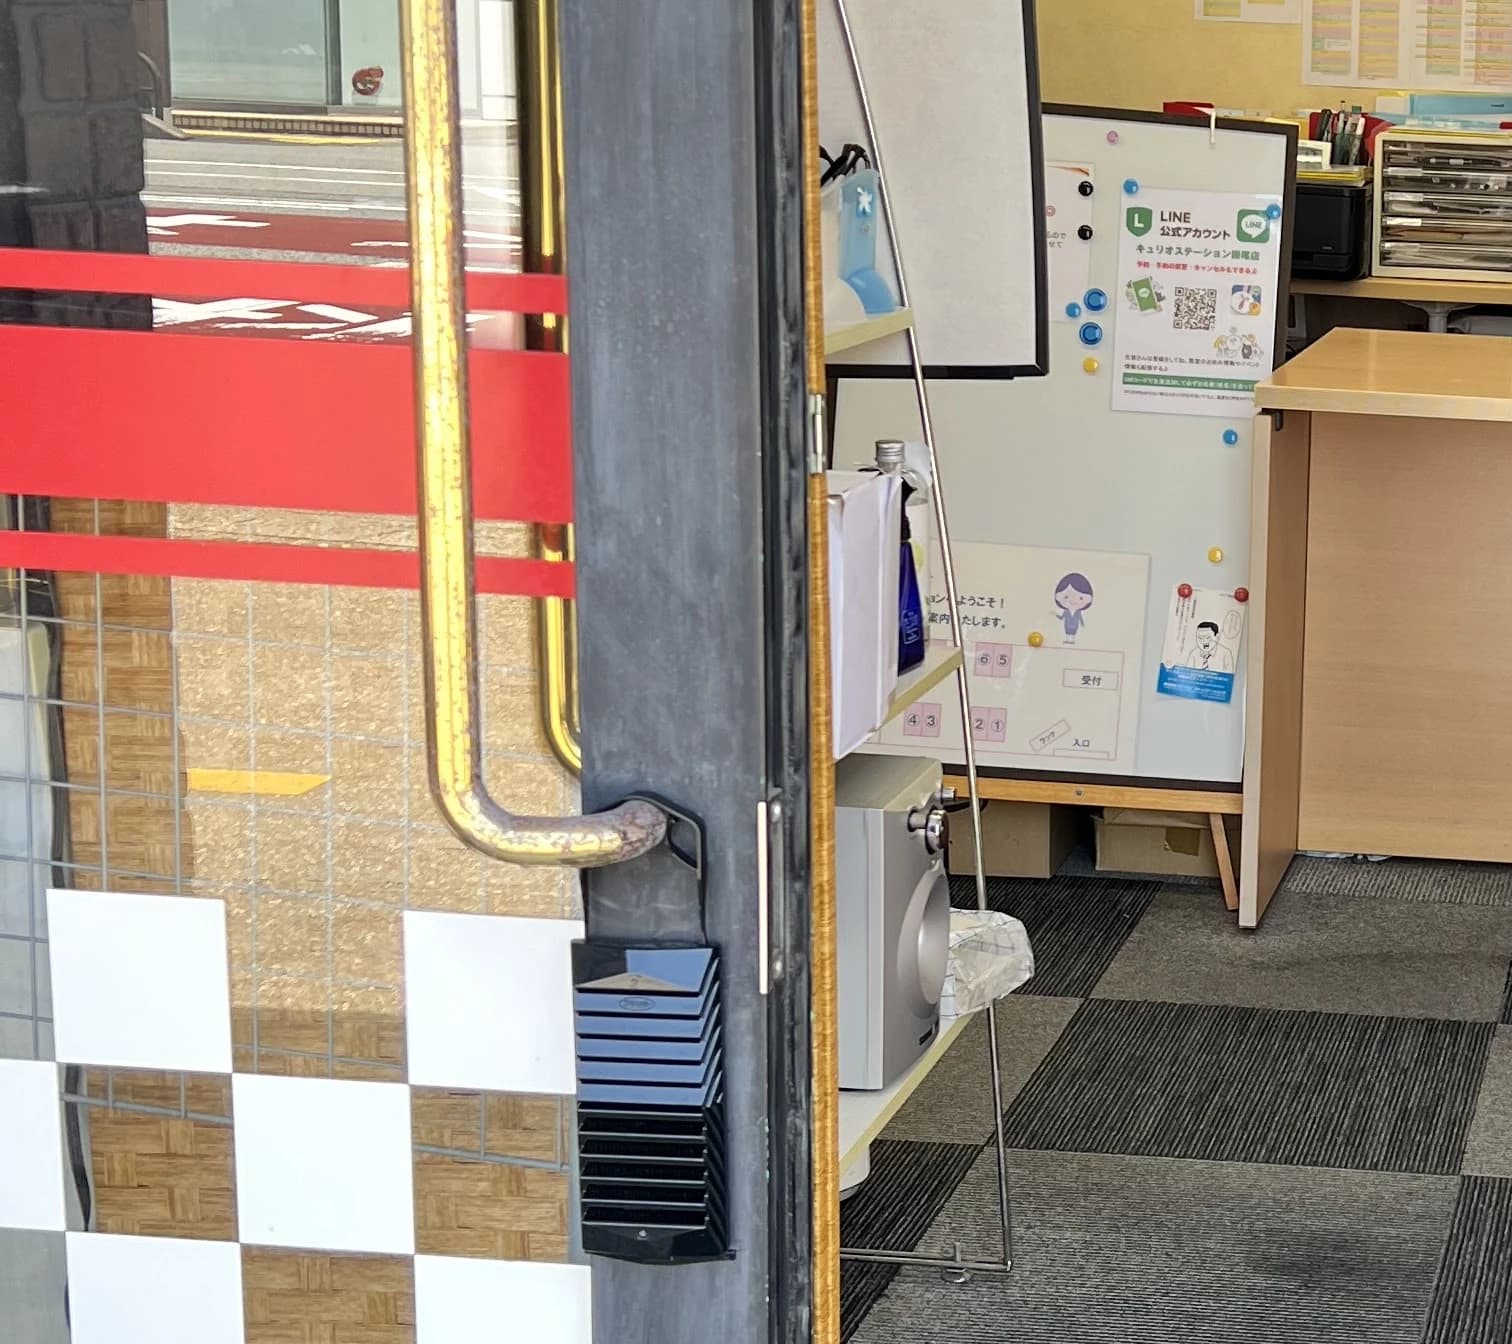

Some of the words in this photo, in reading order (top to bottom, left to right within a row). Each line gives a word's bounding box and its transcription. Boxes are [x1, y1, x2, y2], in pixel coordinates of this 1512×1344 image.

[1160, 210, 1191, 224] LINE
[1159, 225, 1231, 241] 公式アカウント
[1081, 675, 1102, 687] 受付
